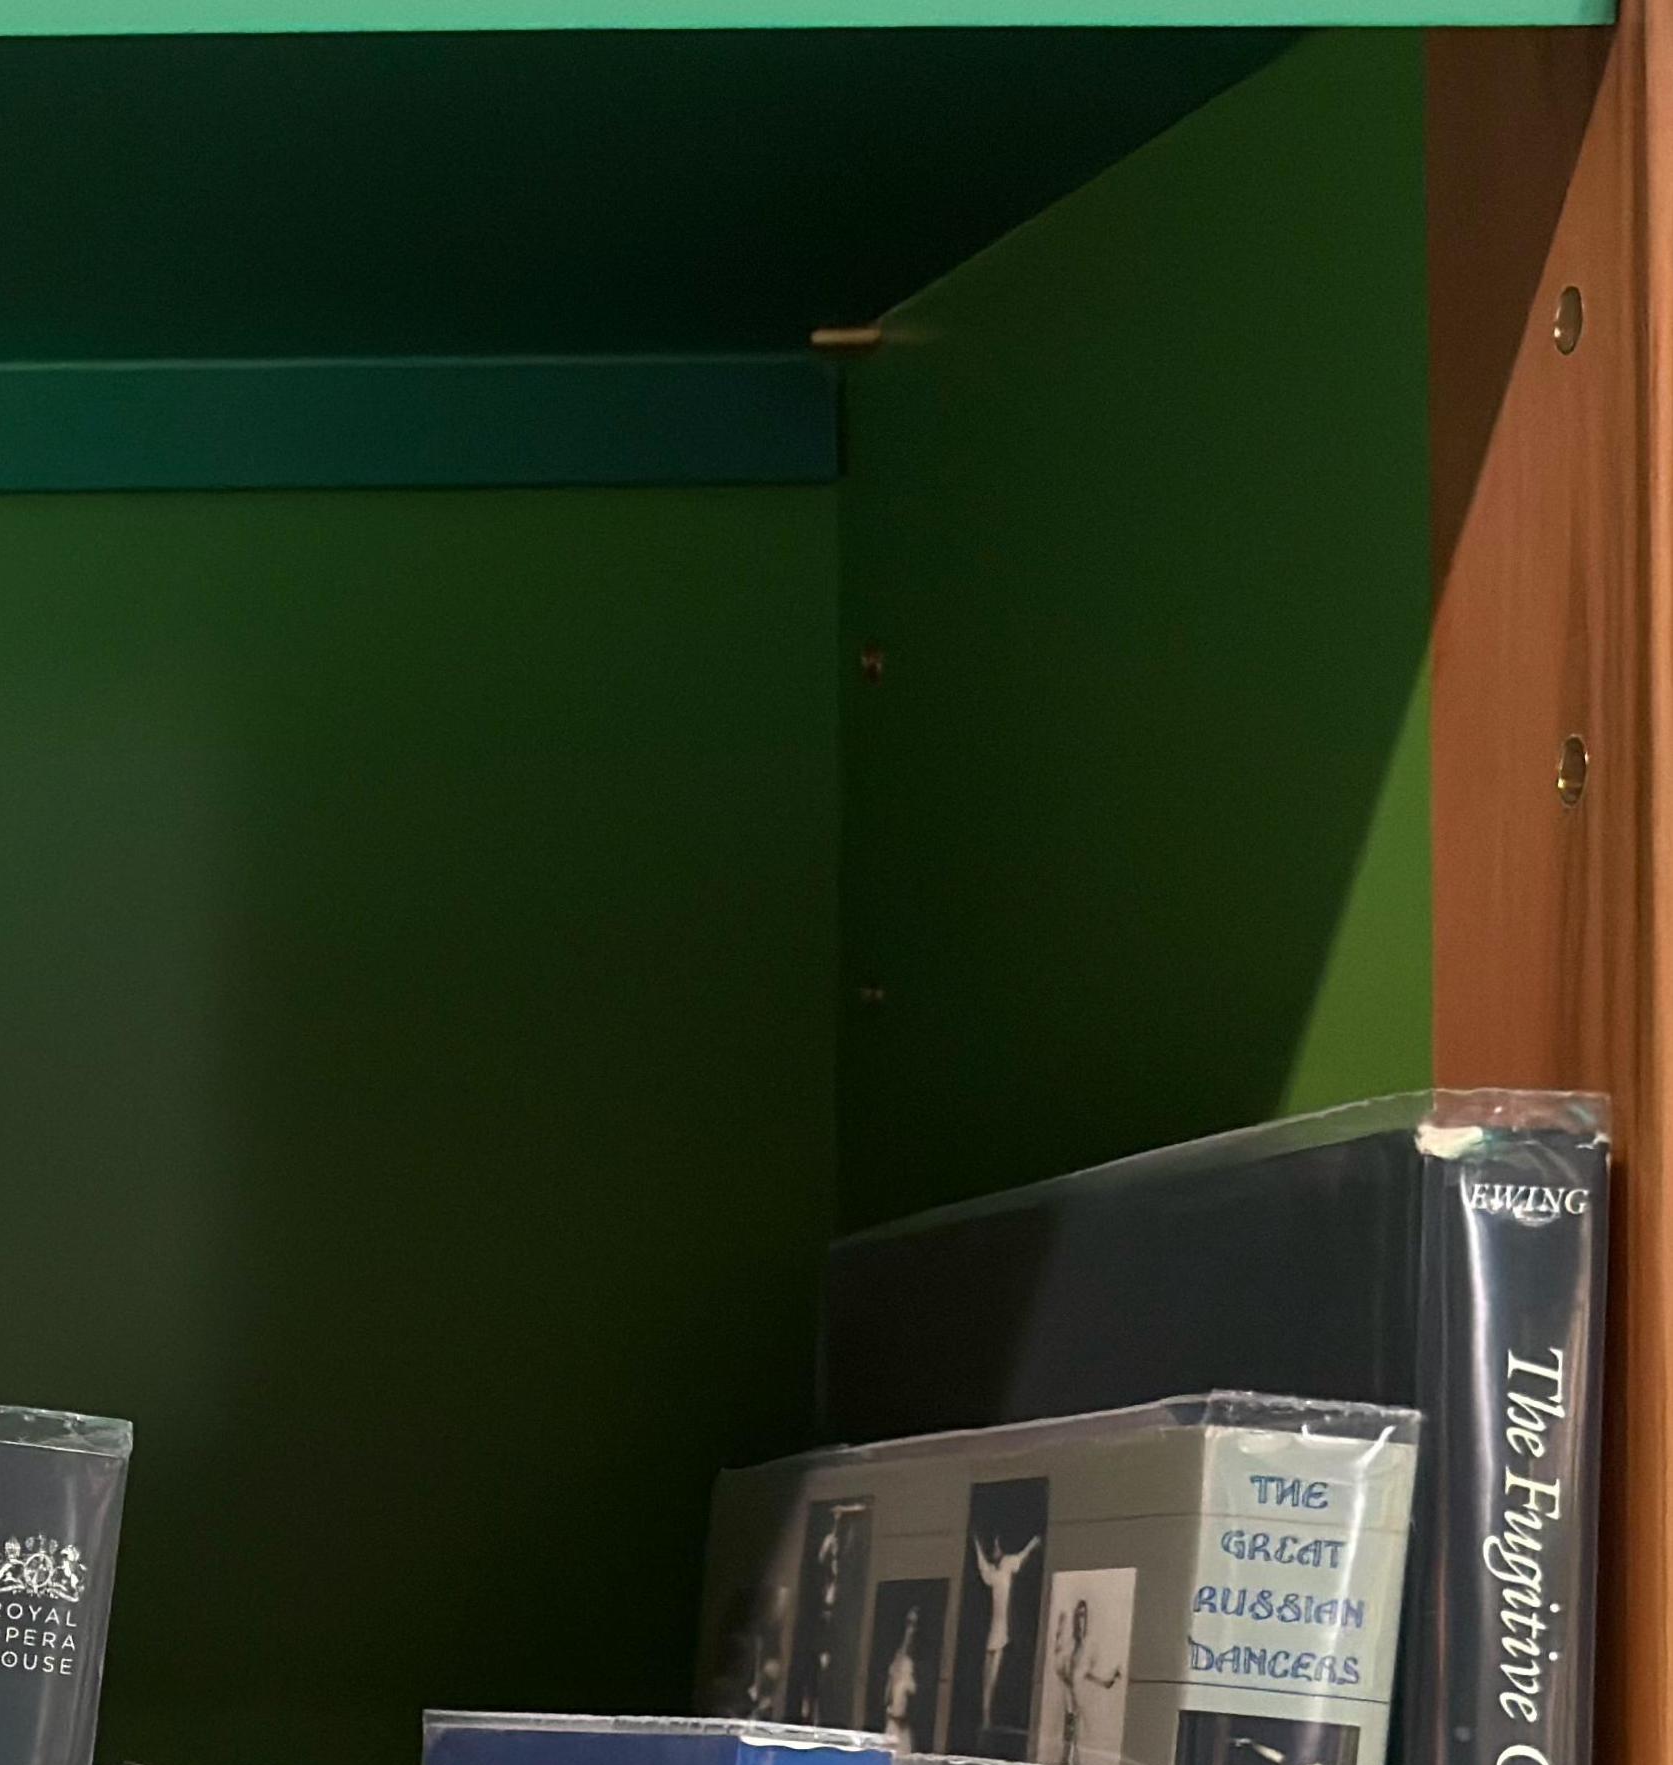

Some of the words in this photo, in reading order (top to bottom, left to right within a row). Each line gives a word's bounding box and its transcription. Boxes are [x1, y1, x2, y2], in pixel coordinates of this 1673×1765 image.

[1470, 1183, 1589, 1215] EWING
[1507, 1347, 1566, 1458] The
[1250, 1475, 1329, 1509] THE
[1221, 1530, 1344, 1568] GREAT
[1193, 1586, 1365, 1628] RUSSIAN
[1483, 1468, 1561, 1723] Fugitive
[1188, 1636, 1360, 1685] DANCERS
